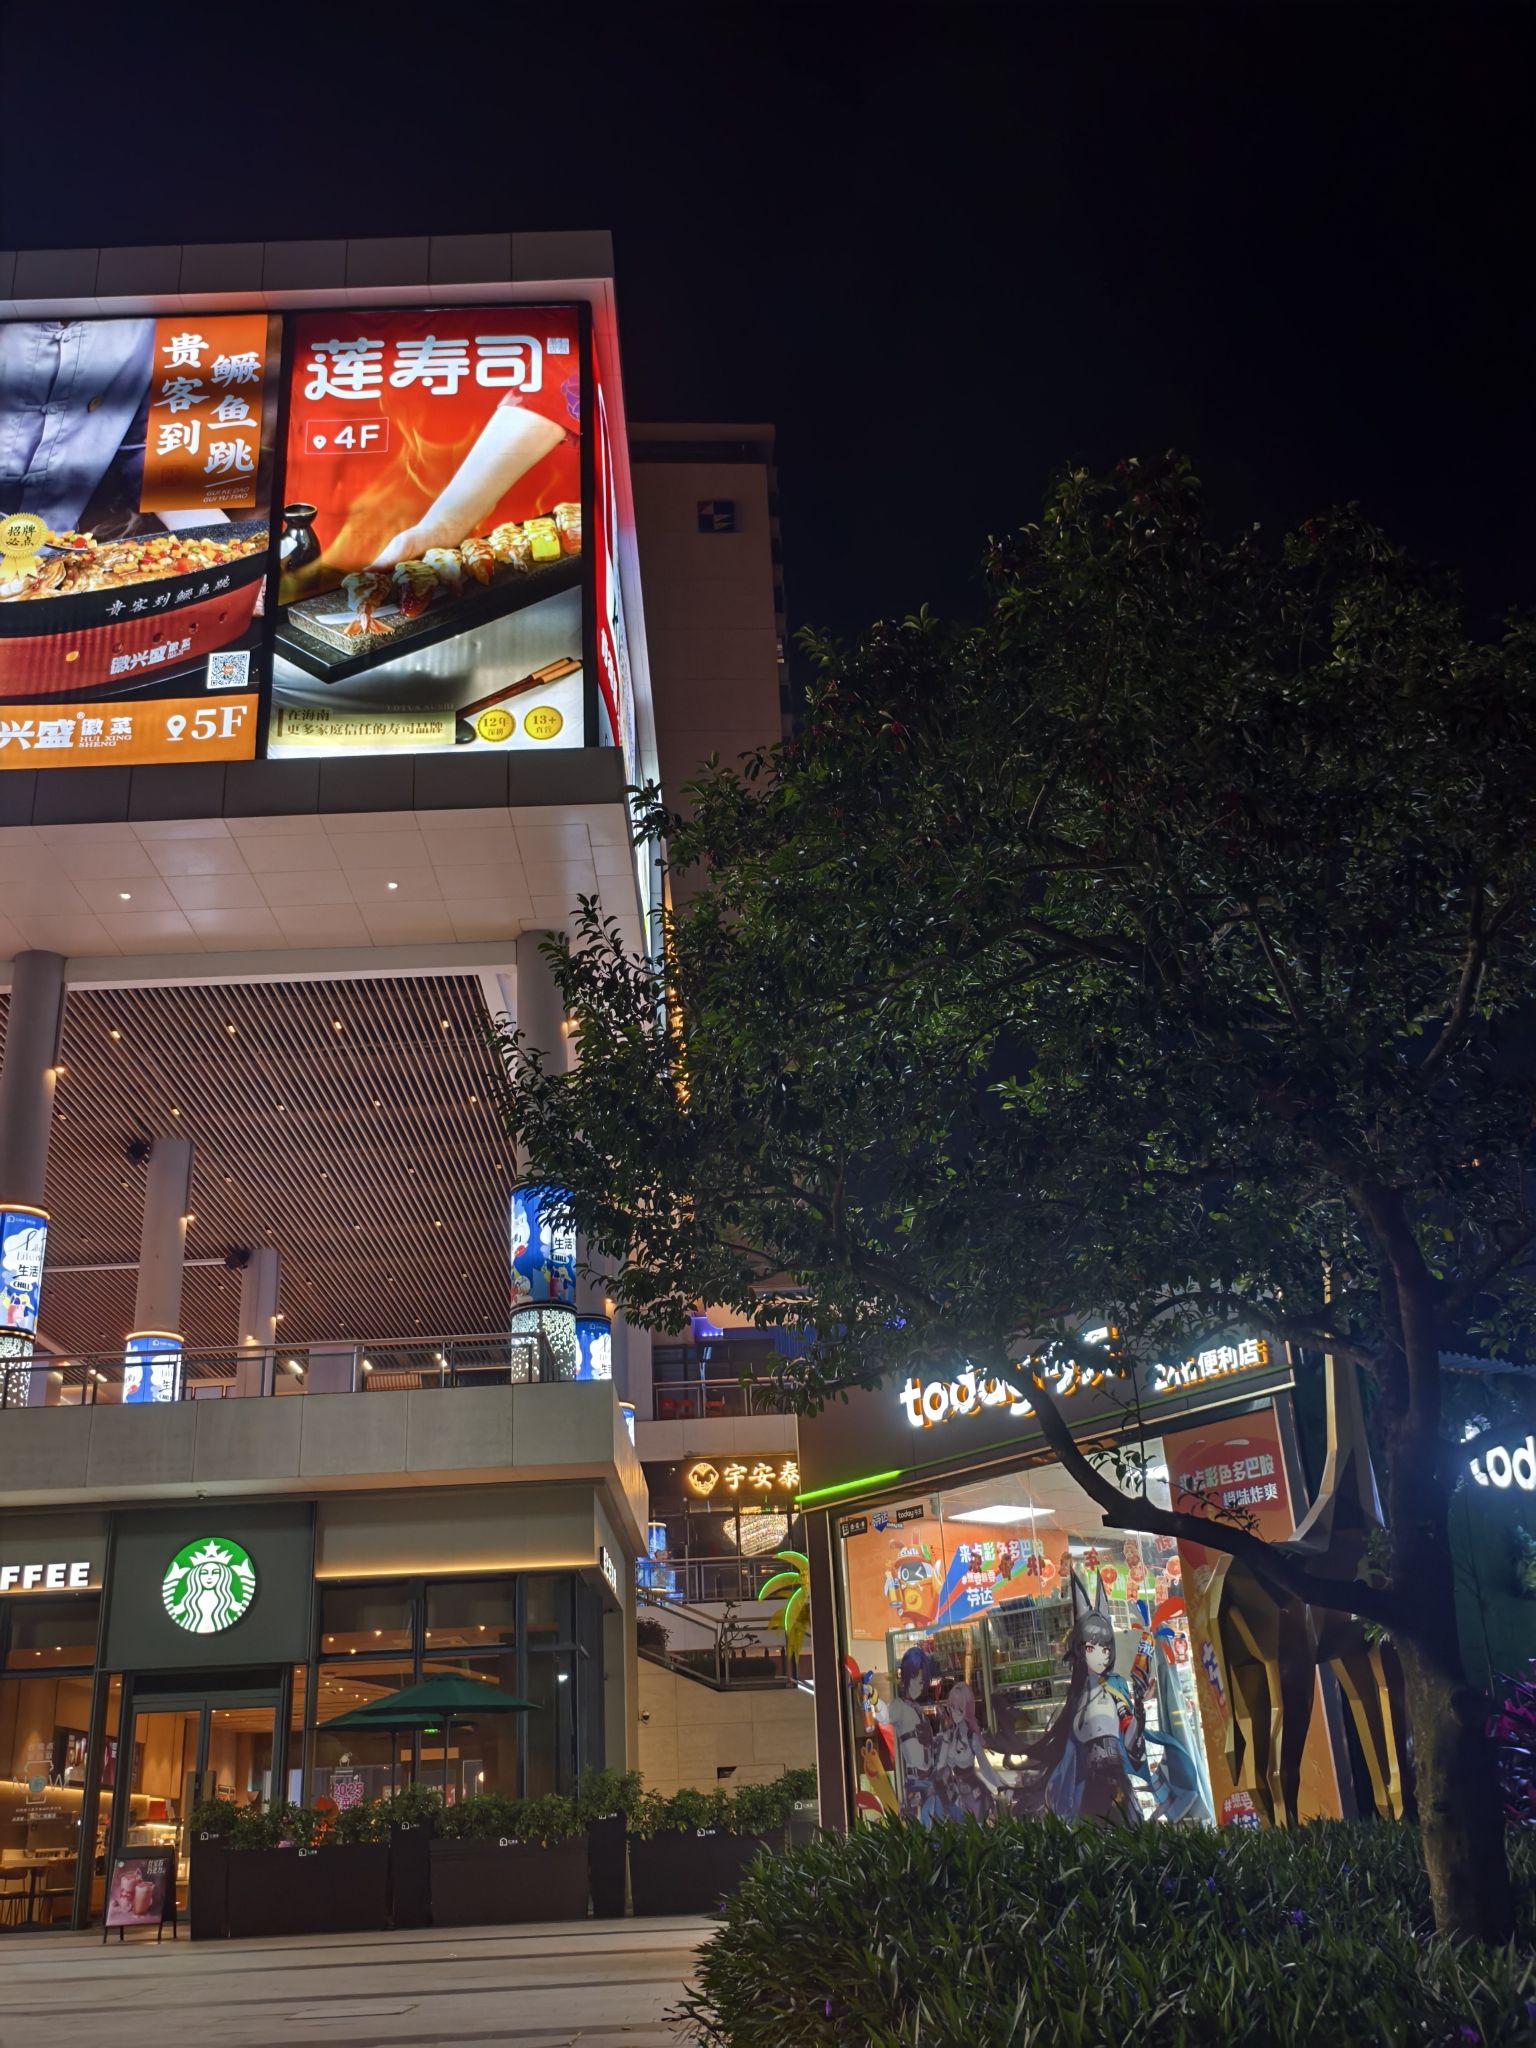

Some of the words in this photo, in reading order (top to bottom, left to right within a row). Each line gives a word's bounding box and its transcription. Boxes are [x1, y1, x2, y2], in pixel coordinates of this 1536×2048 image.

[303, 334, 543, 401] 莲寿司
[153, 332, 211, 456] 贵客到
[203, 351, 262, 475] 鳜鱼跳
[334, 424, 381, 449] 4F
[8, 525, 36, 537] 招牌
[105, 575, 231, 617] 贵客到鳜鱼跳
[191, 705, 248, 740] 5F
[288, 709, 330, 721] 在海南
[534, 715, 556, 724] 13+
[287, 721, 443, 736] 更多家庭信任的寿司品牌
[554, 1237, 573, 1250] 生活
[13, 1264, 39, 1279] 生活
[723, 1460, 800, 1490] 宇安泰
[0, 1562, 90, 1590] FFEE
[966, 1586, 993, 1608] 芬达
